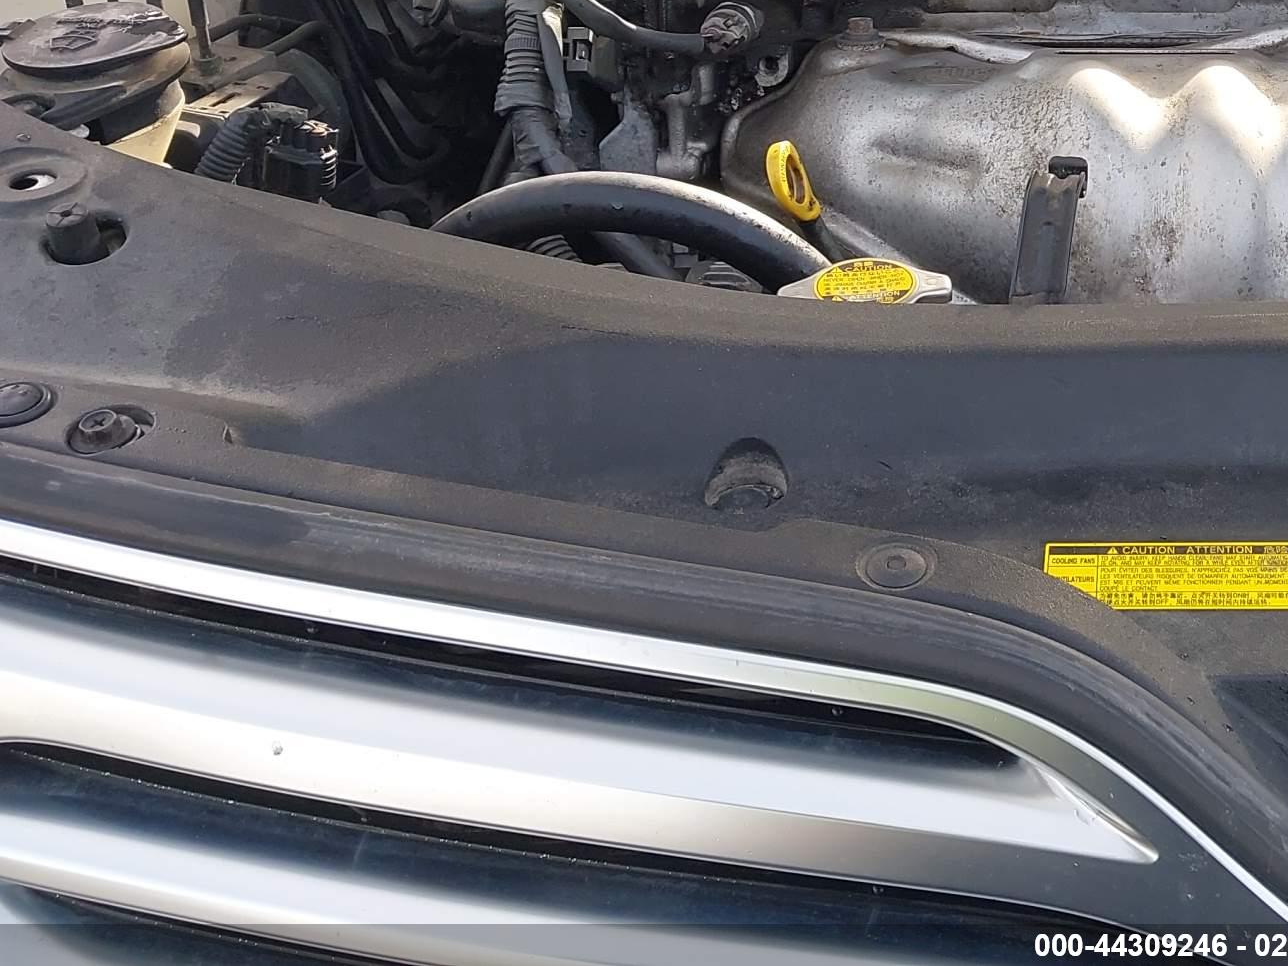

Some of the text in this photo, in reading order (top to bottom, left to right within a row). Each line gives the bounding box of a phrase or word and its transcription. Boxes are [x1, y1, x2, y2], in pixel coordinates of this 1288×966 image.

[845, 264, 892, 272] CAUTION
[1122, 545, 1253, 555] CAUTION ATTENTION
[1079, 557, 1095, 565] FANS
